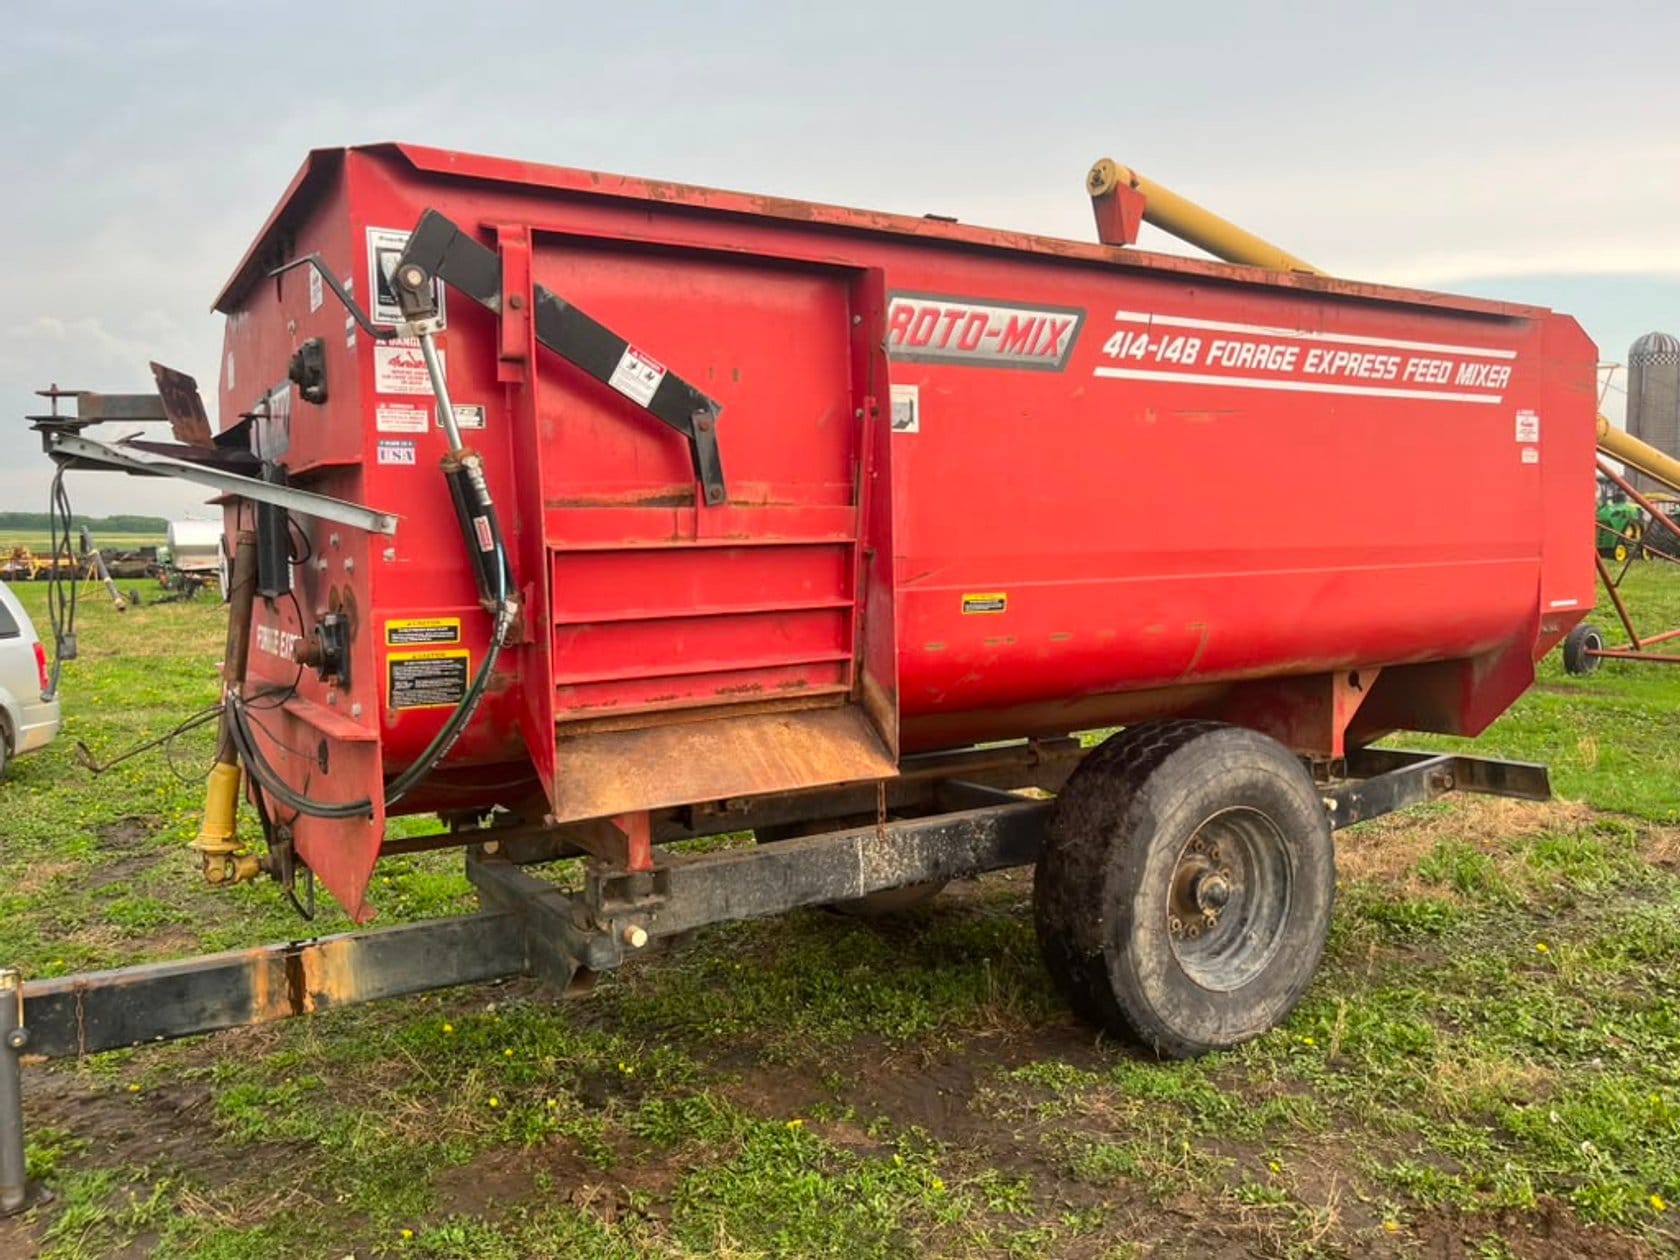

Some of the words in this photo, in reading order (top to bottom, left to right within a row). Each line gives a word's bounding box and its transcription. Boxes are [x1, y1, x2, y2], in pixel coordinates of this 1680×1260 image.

[889, 305, 1071, 357] ROTO-MIX
[1206, 340, 1300, 371] FORAGE
[1303, 349, 1401, 379] EXPRESS
[1403, 358, 1453, 383] FEED
[1455, 363, 1511, 388] MIXER
[380, 449, 413, 460] USA
